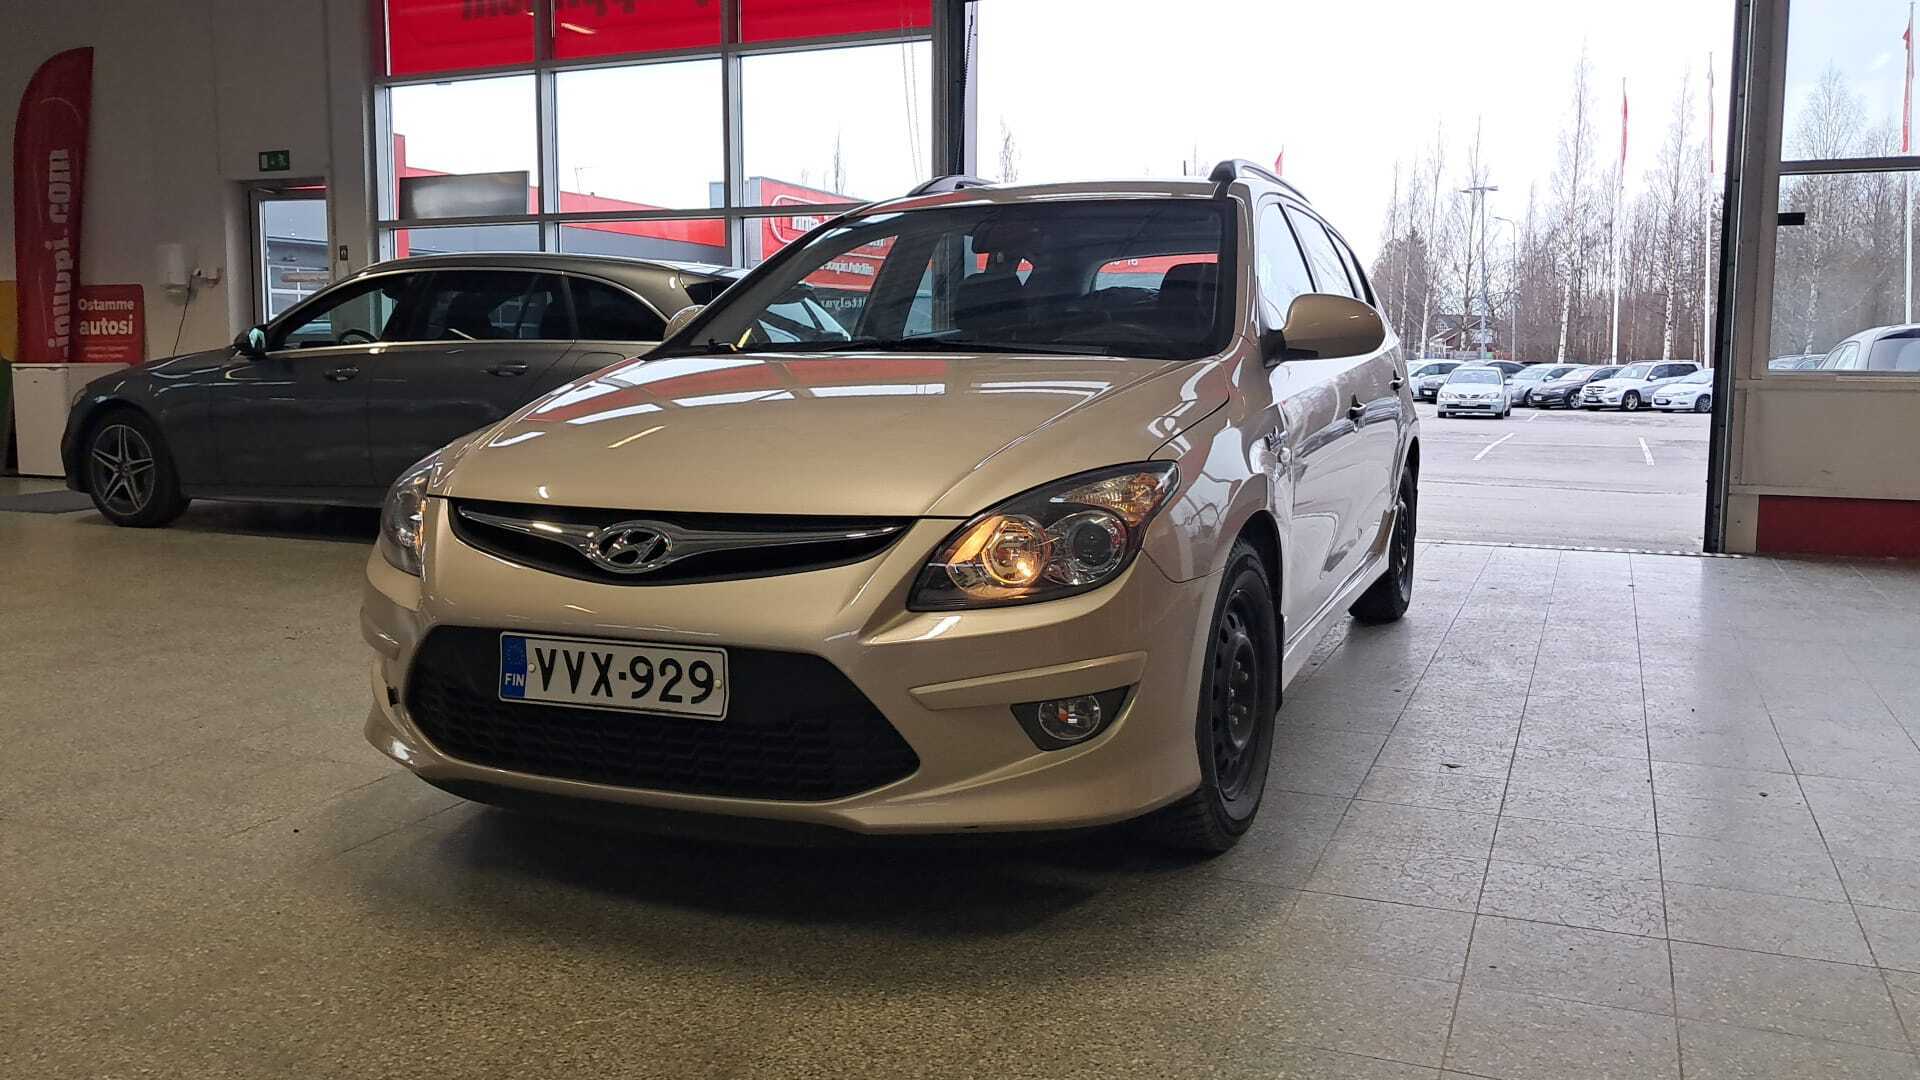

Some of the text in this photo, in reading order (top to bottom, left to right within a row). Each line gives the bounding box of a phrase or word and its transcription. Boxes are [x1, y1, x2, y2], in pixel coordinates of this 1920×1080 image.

[79, 298, 134, 311] Ostamme
[80, 314, 133, 336] autosi
[504, 647, 715, 706] FIN VVX-929
